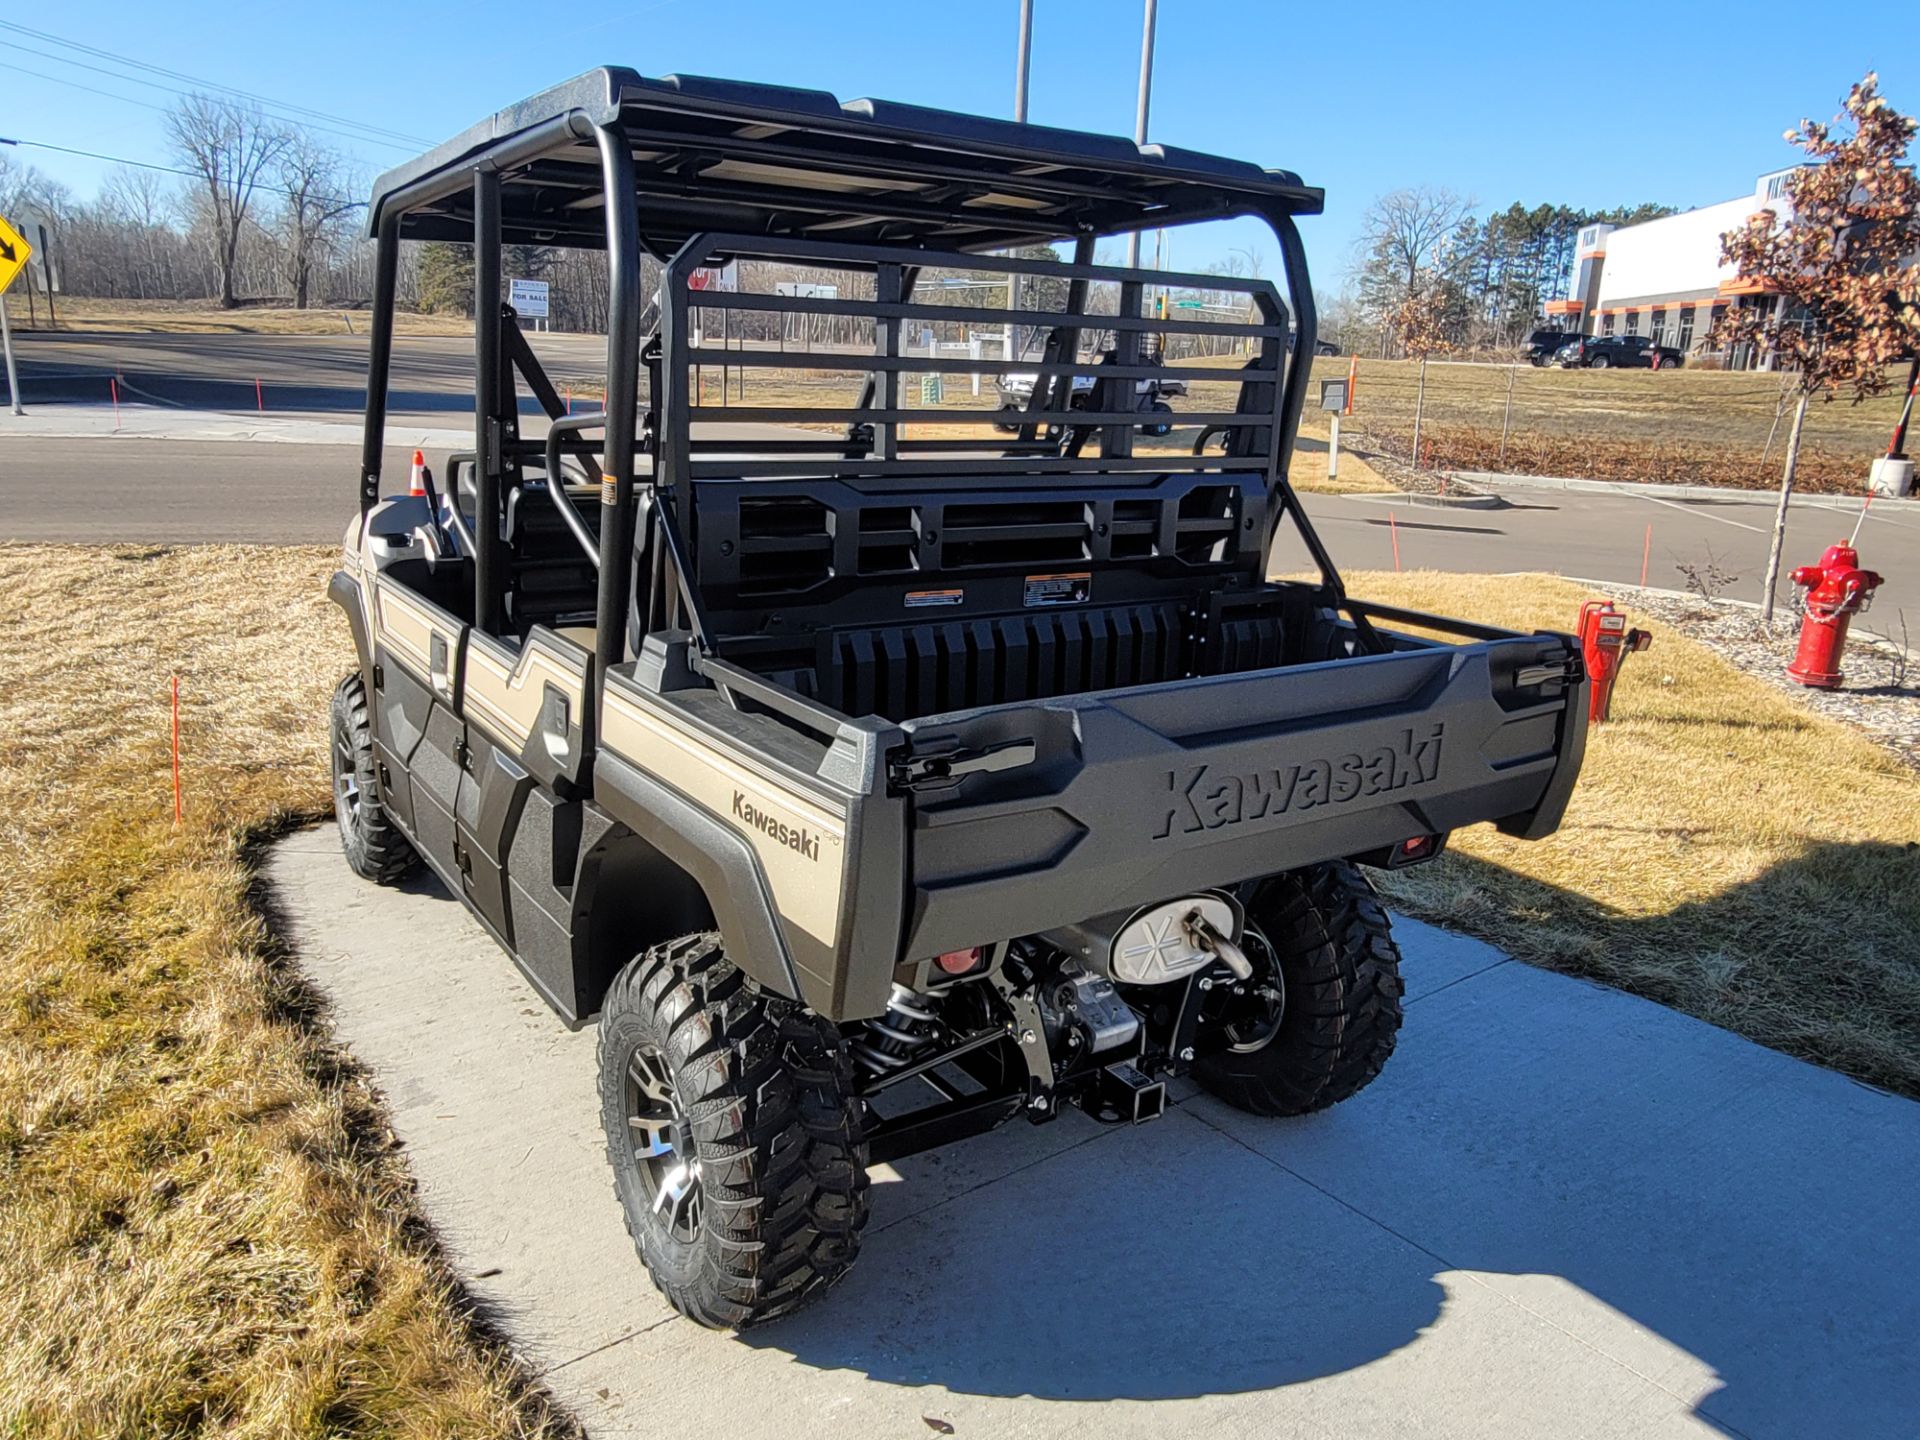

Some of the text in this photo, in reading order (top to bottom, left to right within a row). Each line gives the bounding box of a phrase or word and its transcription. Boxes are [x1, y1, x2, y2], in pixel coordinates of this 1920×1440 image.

[512, 293, 527, 301] FOR
[1152, 723, 1445, 840] Kawasaki
[731, 789, 820, 863] Kawasaki
